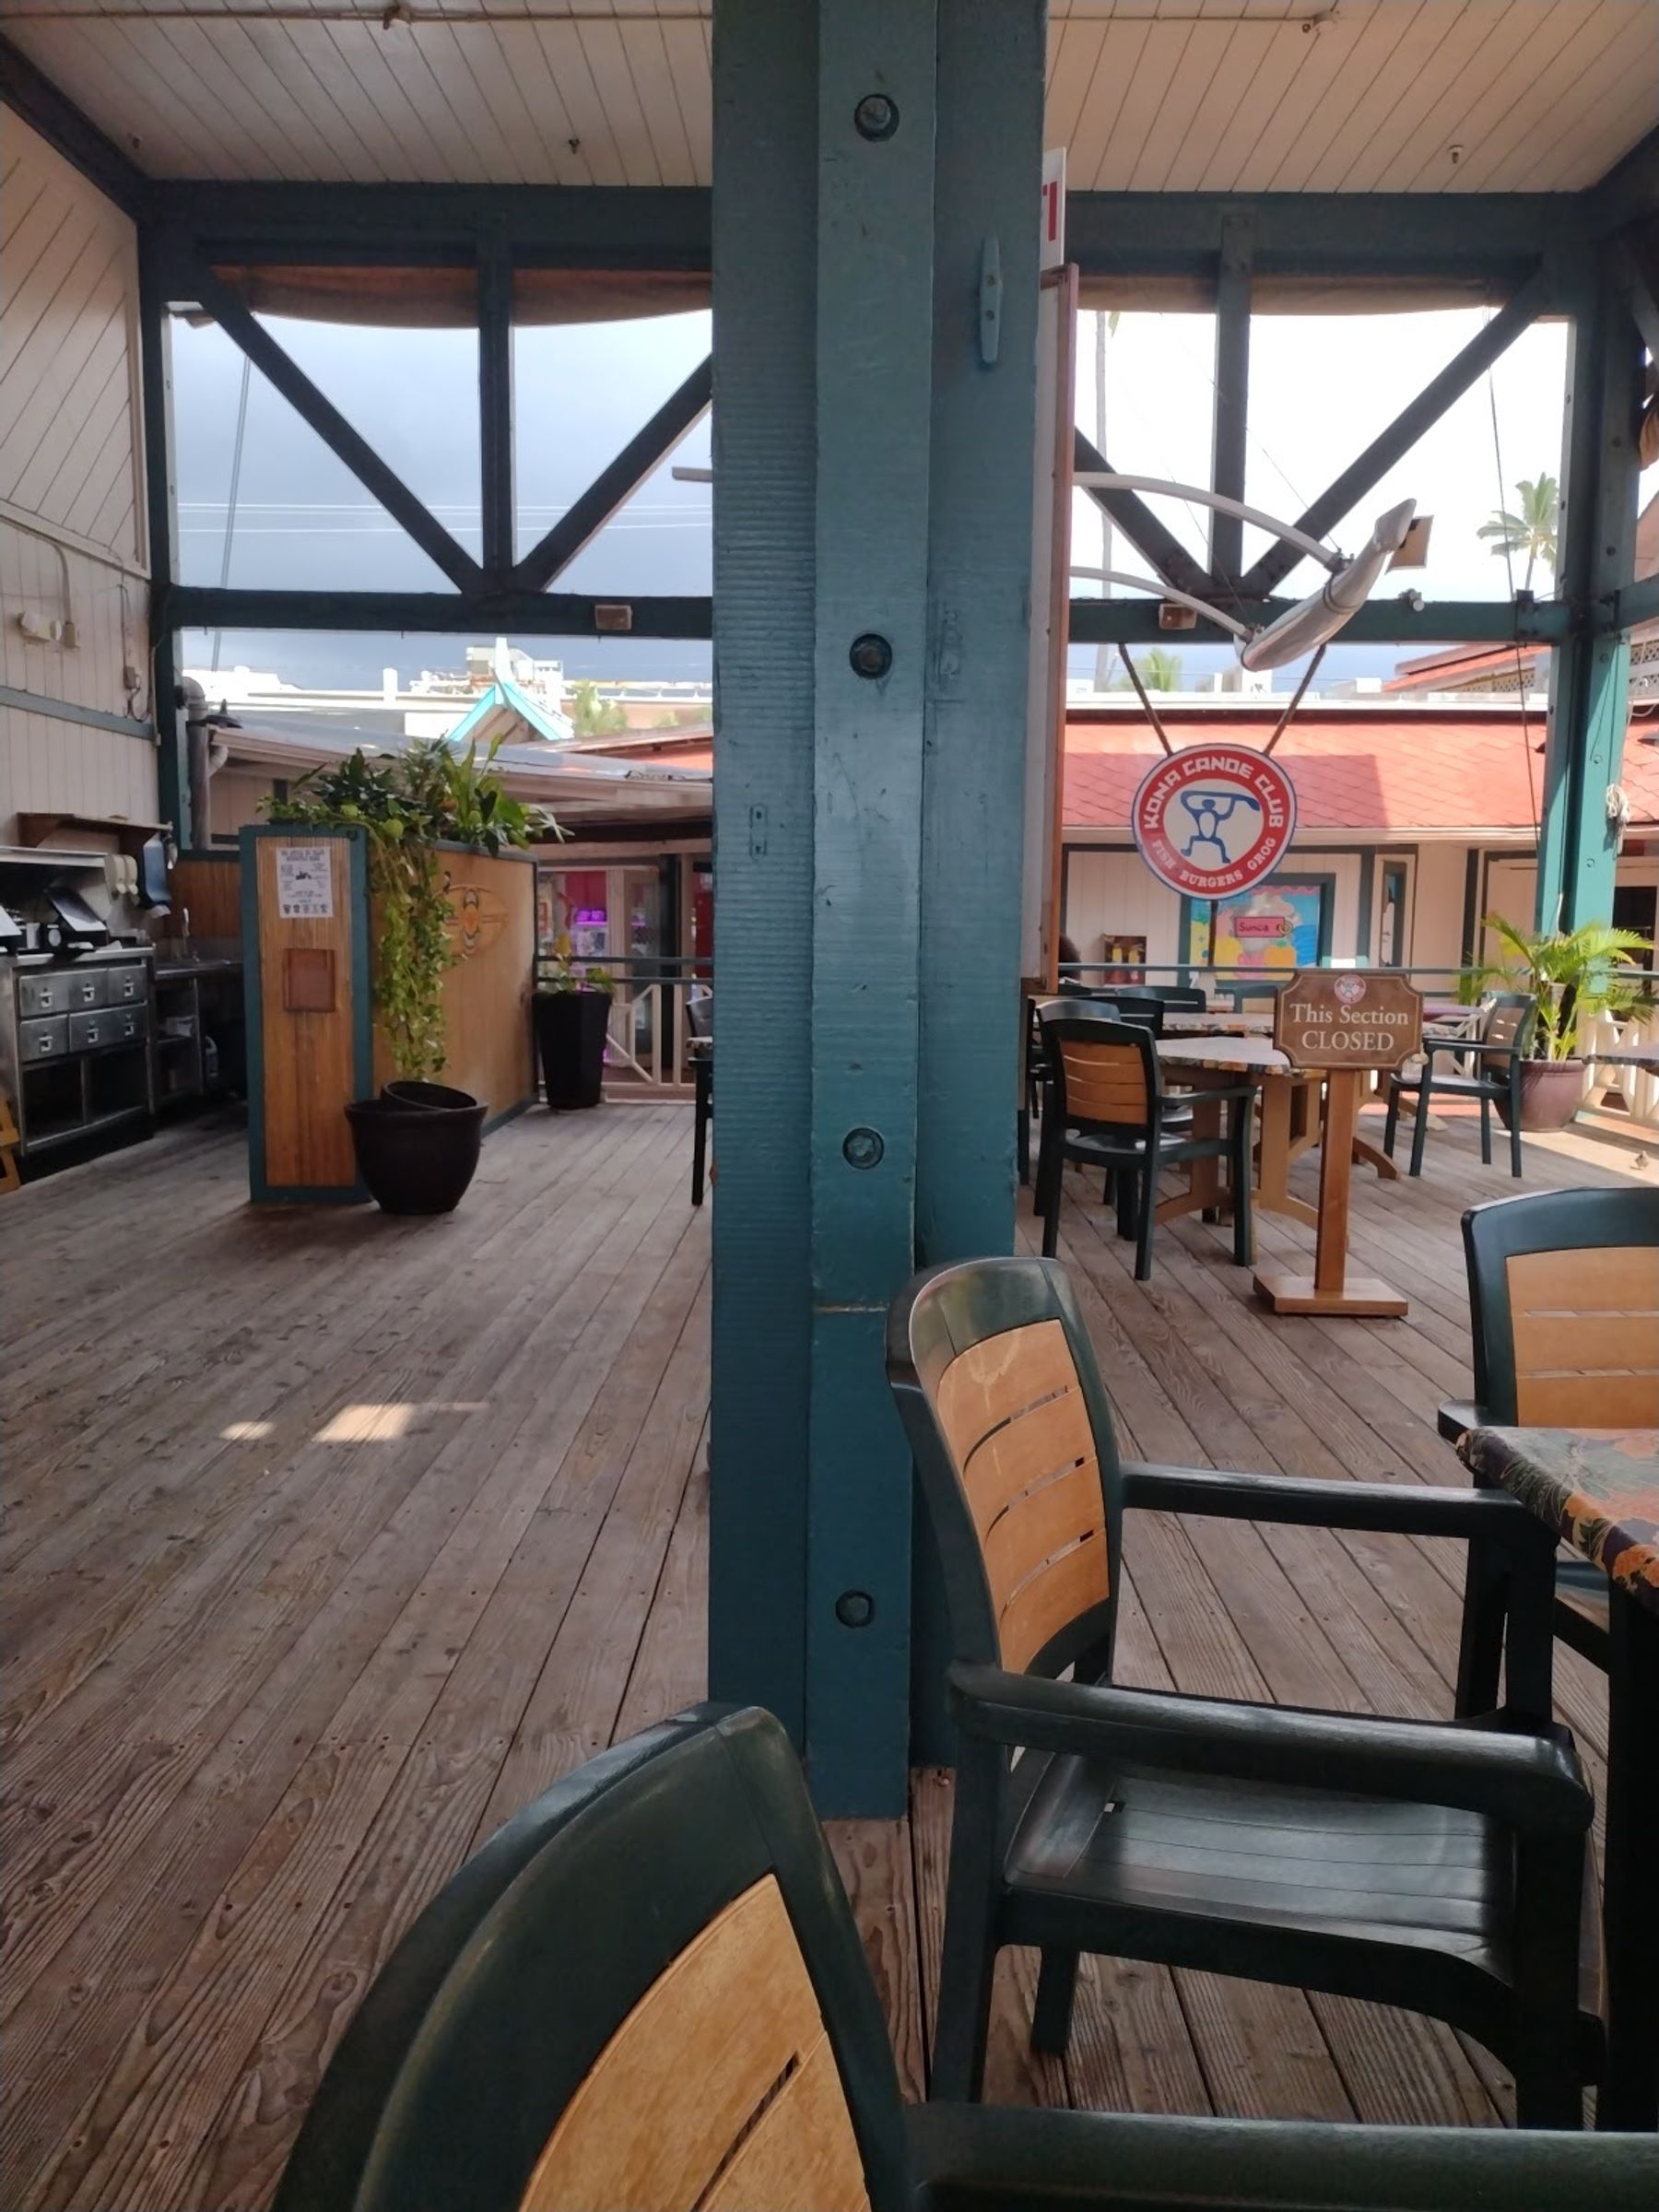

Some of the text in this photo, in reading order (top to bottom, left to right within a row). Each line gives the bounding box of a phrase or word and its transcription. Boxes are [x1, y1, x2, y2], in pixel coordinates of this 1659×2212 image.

[1144, 756, 1283, 829] KONA CANOE CLUB
[1152, 838, 1276, 888] FISH BURGERS GROG
[1289, 1003, 1409, 1025] This Section
[1301, 1030, 1394, 1051] CLOSED
